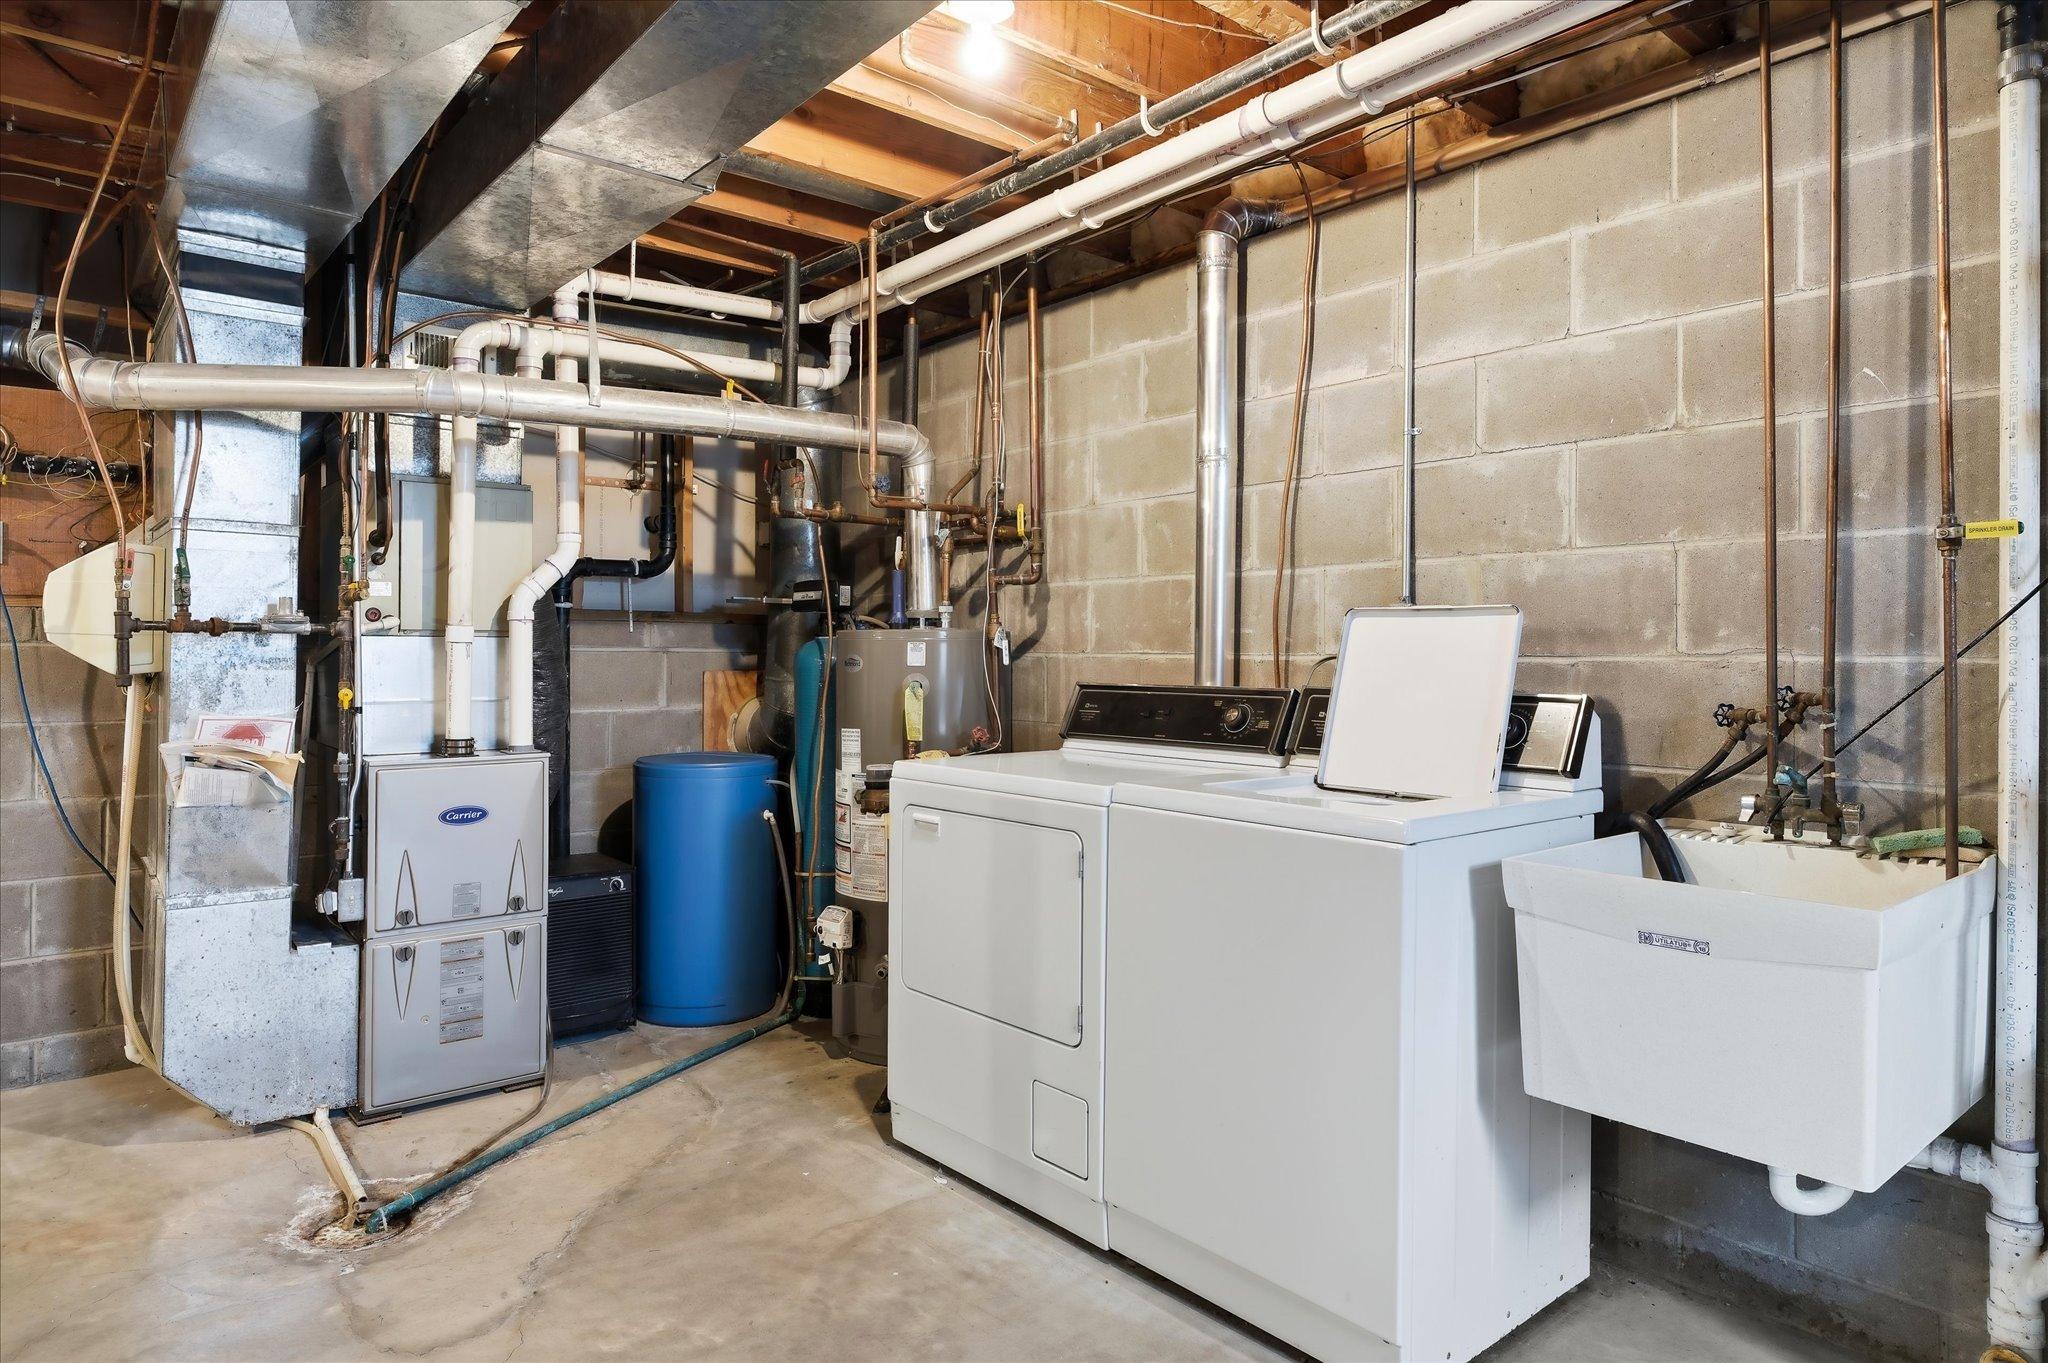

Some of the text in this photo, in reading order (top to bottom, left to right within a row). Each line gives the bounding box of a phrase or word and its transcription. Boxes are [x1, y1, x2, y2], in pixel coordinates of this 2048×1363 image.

[2009, 200, 2018, 212] 40
[2009, 217, 2018, 235] SCH
[2009, 239, 2018, 259] 1120
[2009, 262, 2018, 280] PVC
[2009, 636, 2018, 655] 1120
[2008, 660, 2018, 677] PVC
[446, 810, 483, 820] Carrier
[2006, 996, 2016, 1009] 40
[2006, 1013, 2016, 1031] SCH
[2006, 1036, 2016, 1055] 1120
[2005, 1060, 2015, 1077] PVC
